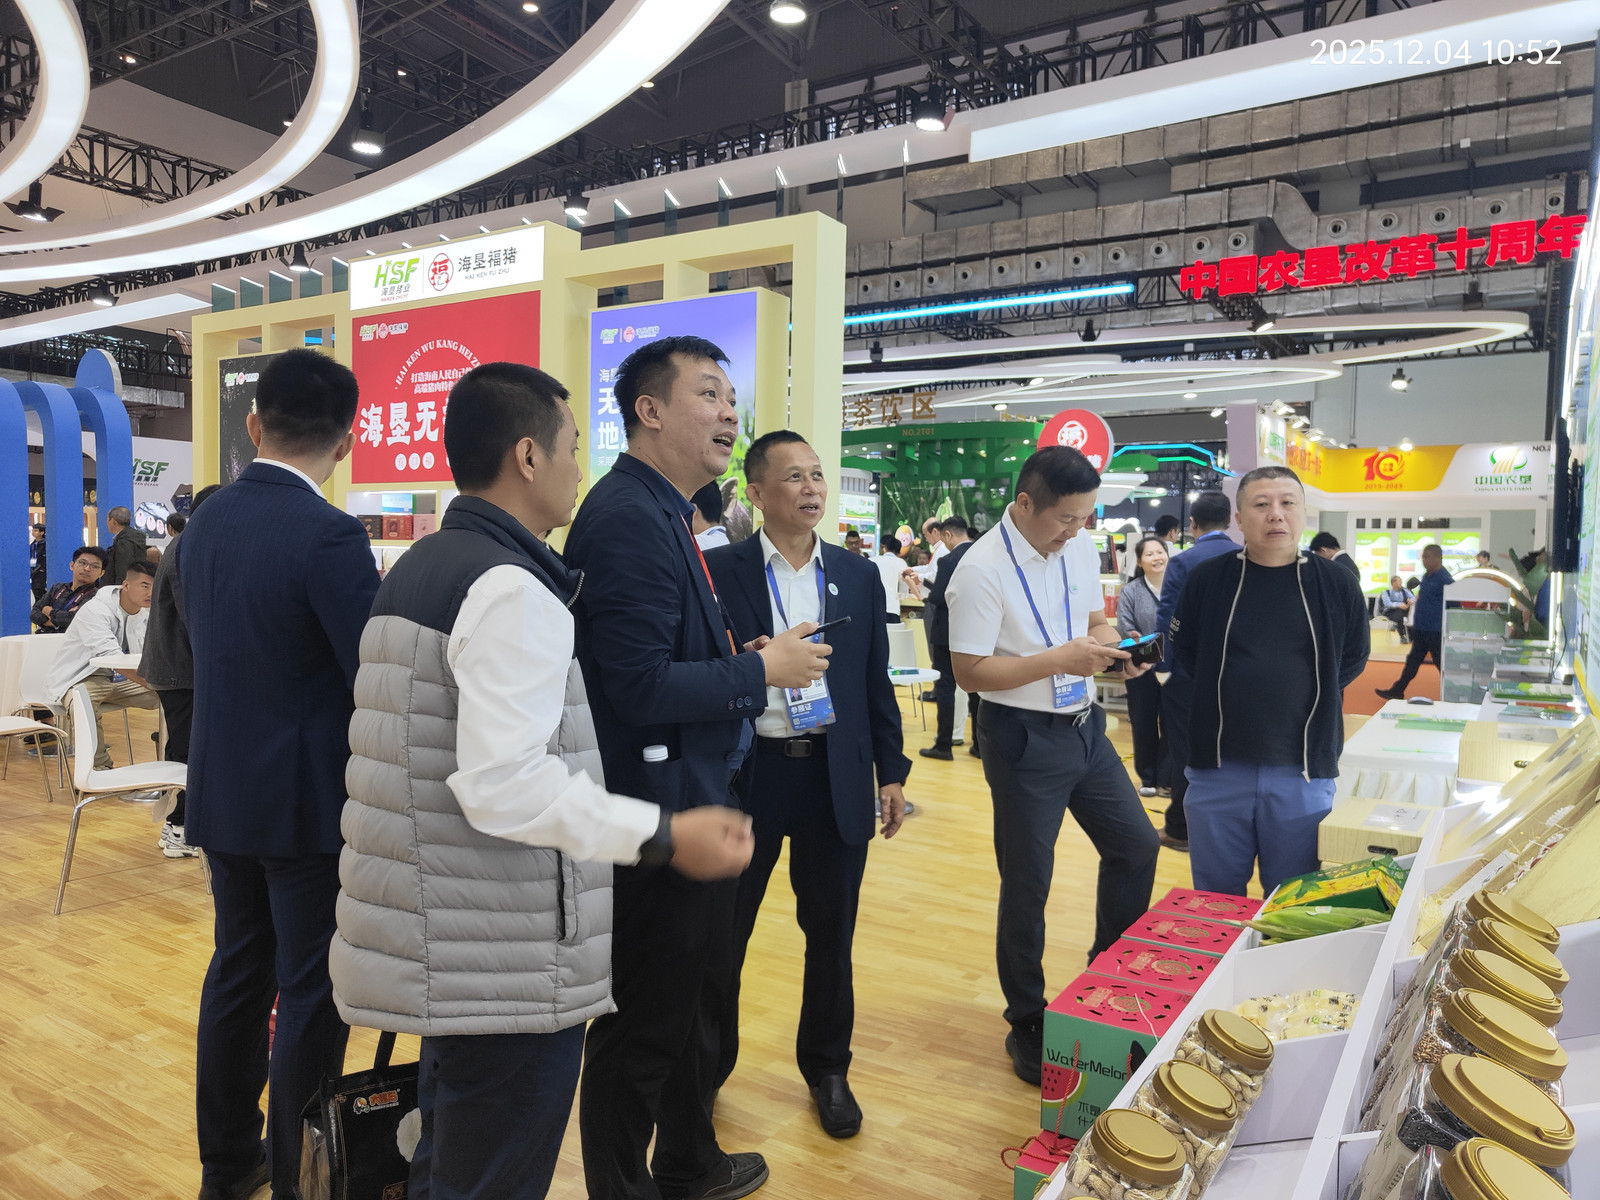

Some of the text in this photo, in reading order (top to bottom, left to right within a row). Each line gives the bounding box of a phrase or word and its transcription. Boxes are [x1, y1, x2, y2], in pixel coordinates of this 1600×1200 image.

[458, 246, 517, 272] 海垦福猪
[1180, 214, 1588, 300] 中国农垦改革十周年
[375, 258, 420, 288] HSF
[395, 365, 409, 385] HAI
[406, 349, 421, 367] KEN
[420, 341, 436, 353] WU
[436, 339, 459, 351] KANG
[360, 400, 449, 448] 海垦无
[902, 428, 935, 437] NO.2T01
[1475, 475, 1532, 485] 中国农垦
[791, 702, 812, 714] 参展证
